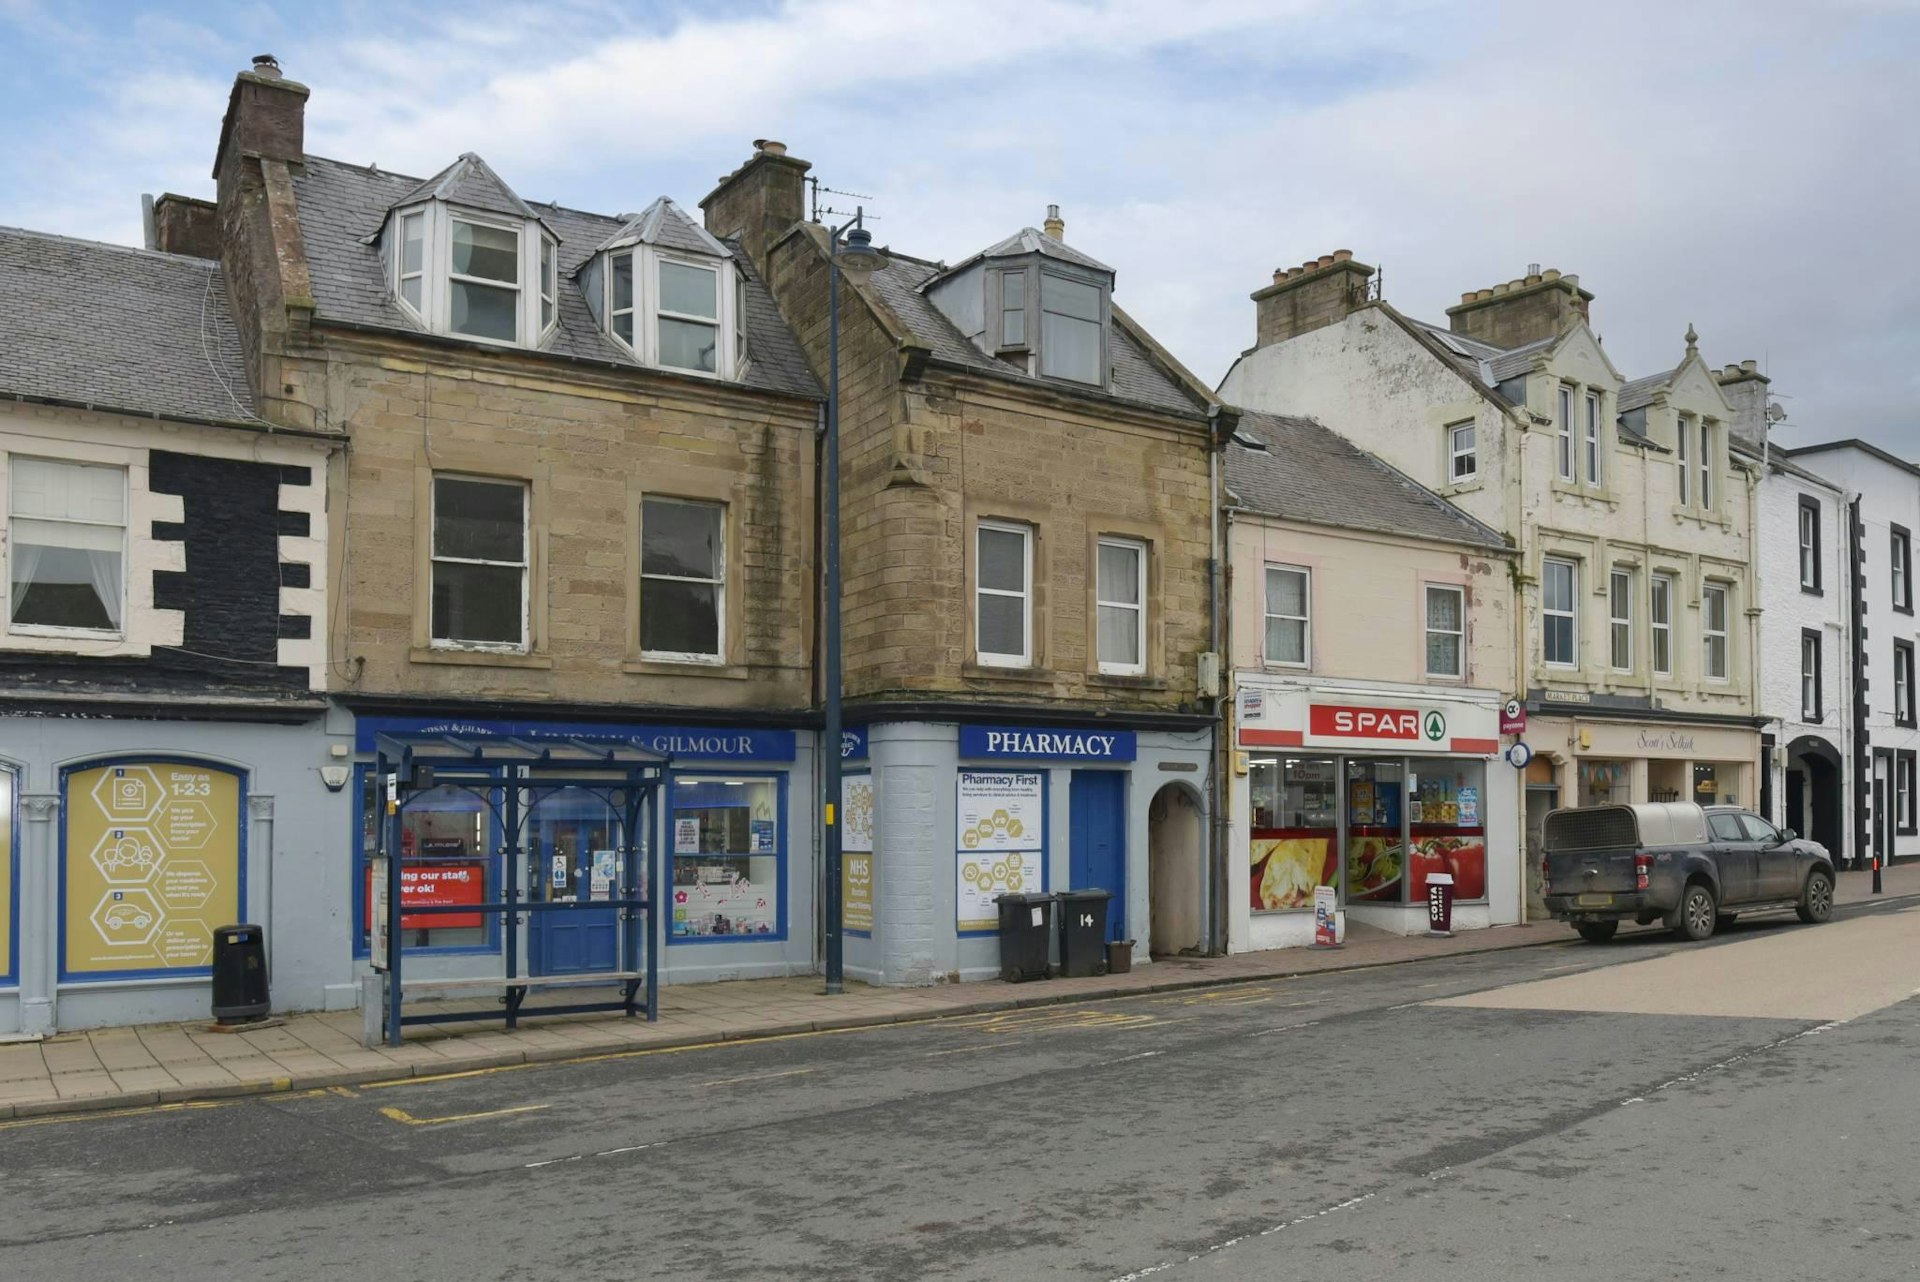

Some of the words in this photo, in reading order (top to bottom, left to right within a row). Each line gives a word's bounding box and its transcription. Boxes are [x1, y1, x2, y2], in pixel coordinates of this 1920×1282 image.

[1335, 711, 1417, 734] SPAR
[653, 735, 753, 754] GILMOUR
[987, 732, 1115, 755] PHARMACY
[171, 772, 196, 783] Easy
[962, 774, 1014, 787] Pharmacy
[1016, 775, 1038, 785] First
[171, 783, 211, 796] 1-2-3
[850, 859, 869, 876] NHS
[417, 884, 435, 893] ok!
[1430, 886, 1439, 921] COSTA
[1080, 914, 1094, 927] 14
